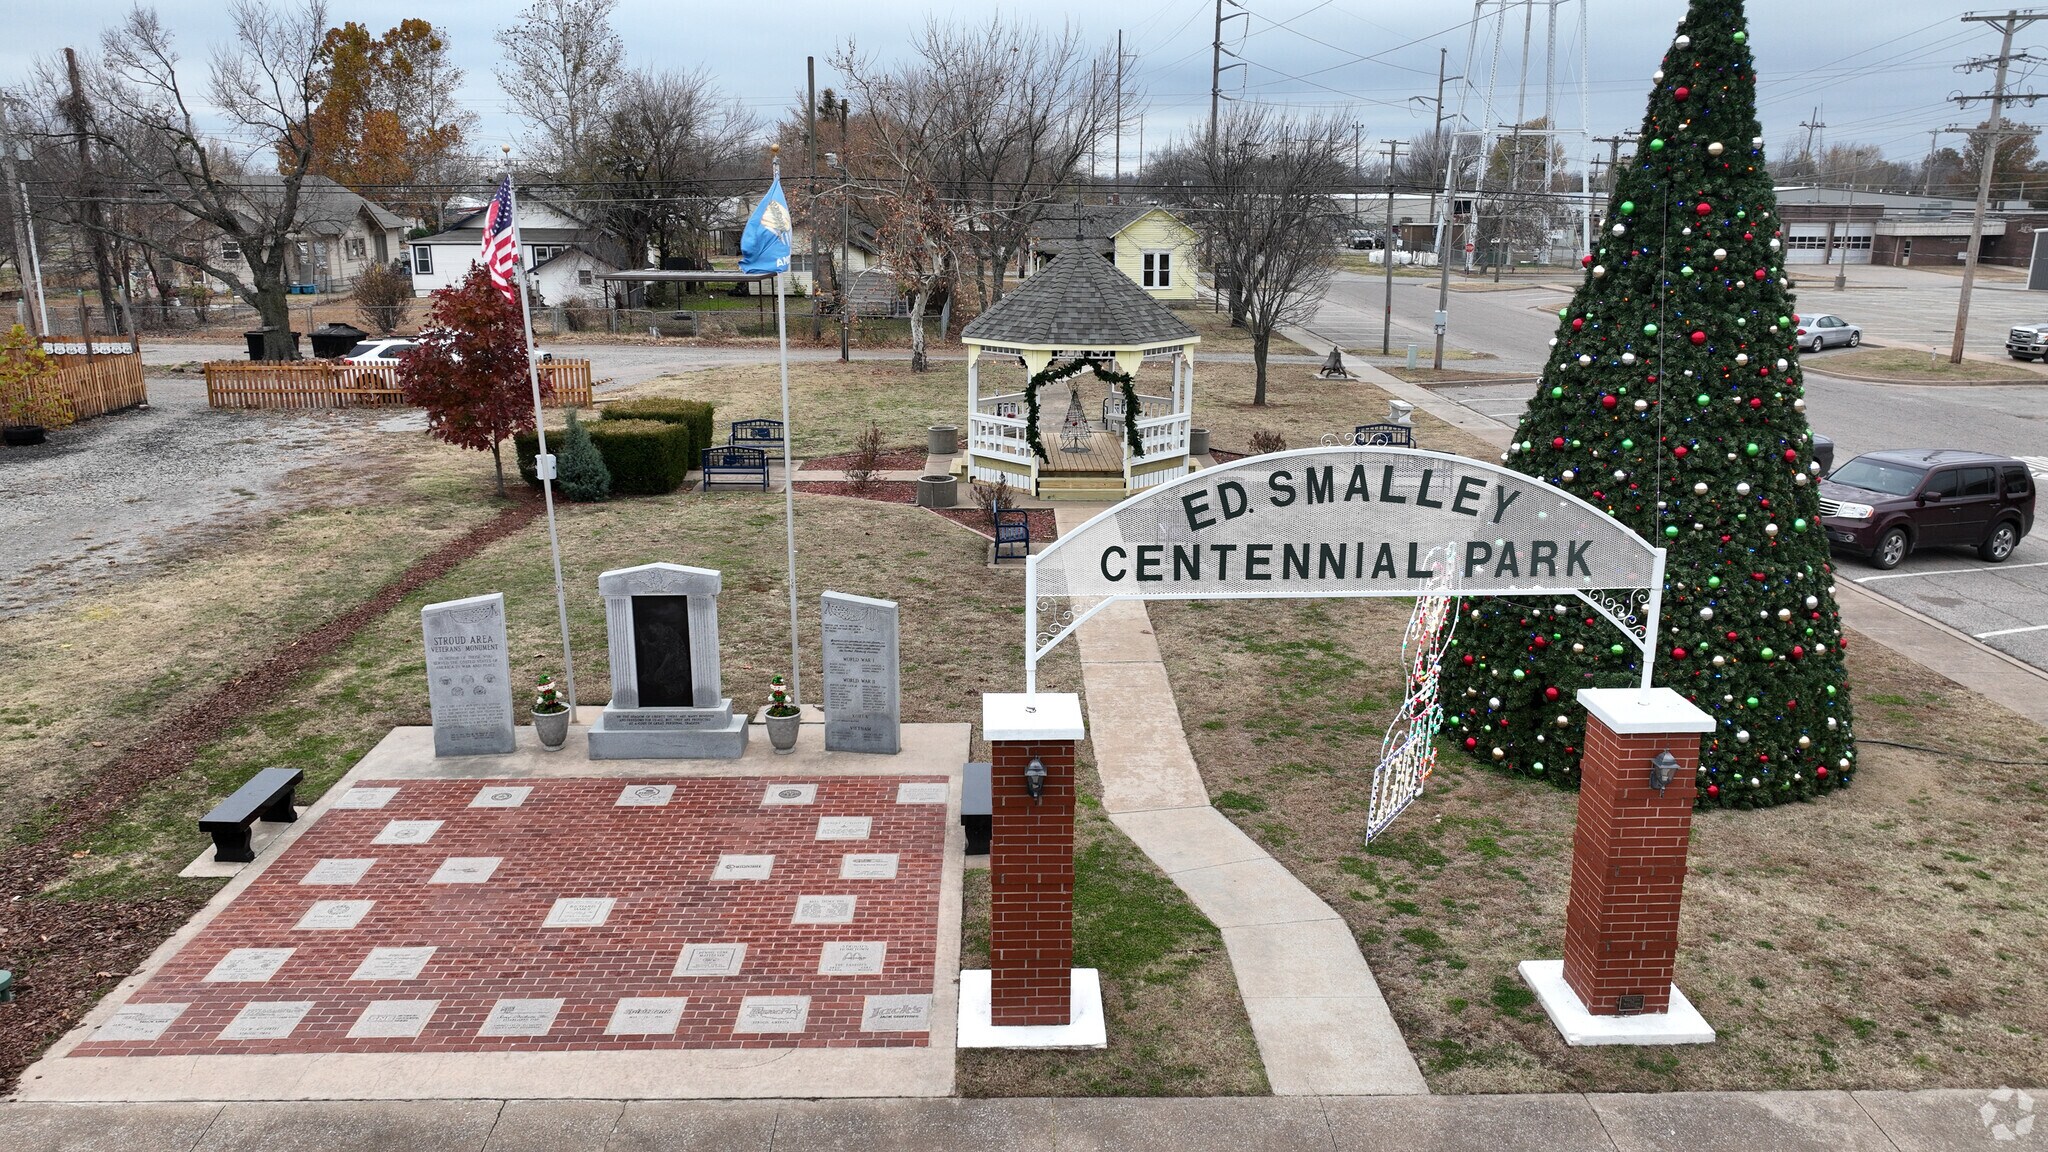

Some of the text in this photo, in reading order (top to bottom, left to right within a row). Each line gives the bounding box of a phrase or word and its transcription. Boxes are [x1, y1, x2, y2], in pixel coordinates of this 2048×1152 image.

[1181, 464, 1522, 532] ED. SMALLEY
[1100, 540, 1594, 582] CENTENNIAL PARK
[430, 645, 461, 653] VETERANS
[433, 634, 493, 646] STROUD AREA
